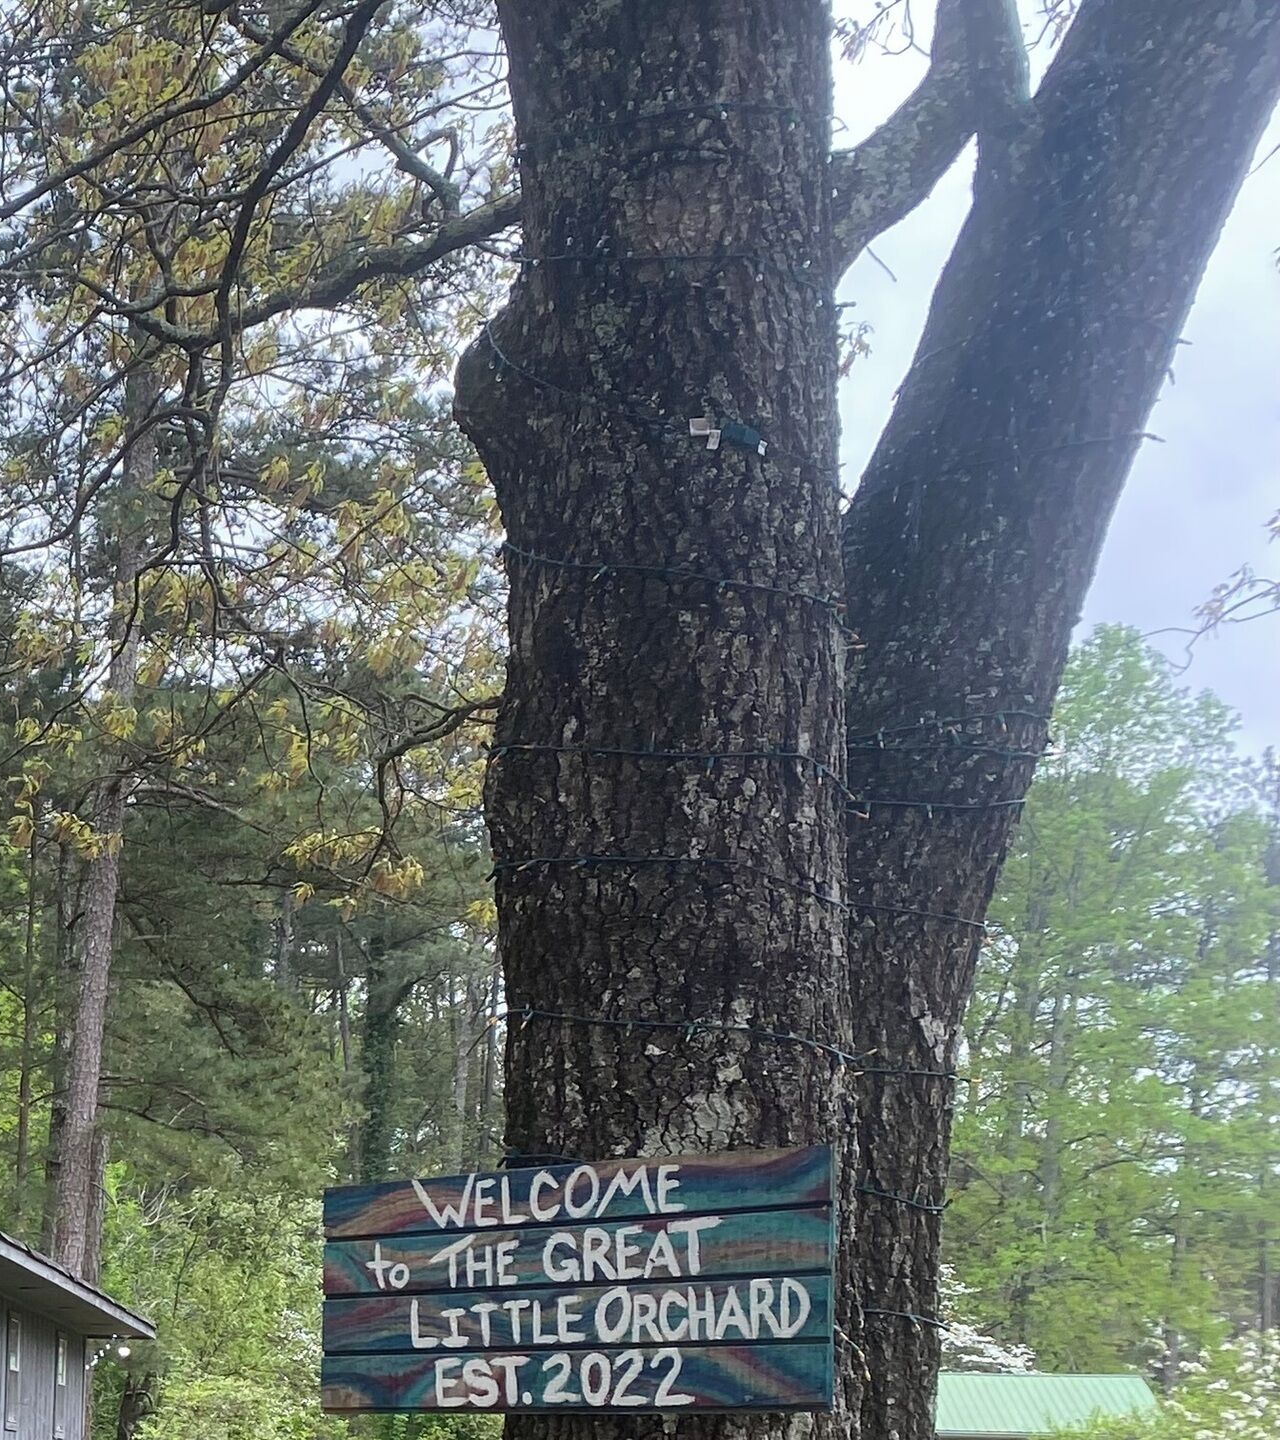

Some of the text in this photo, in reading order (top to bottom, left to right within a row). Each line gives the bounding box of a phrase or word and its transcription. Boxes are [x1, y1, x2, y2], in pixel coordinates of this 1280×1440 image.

[411, 1163, 688, 1229] WELCOME
[365, 1215, 727, 1289] to THE GREAT
[409, 1276, 812, 1349] LITTLE ORCHARD
